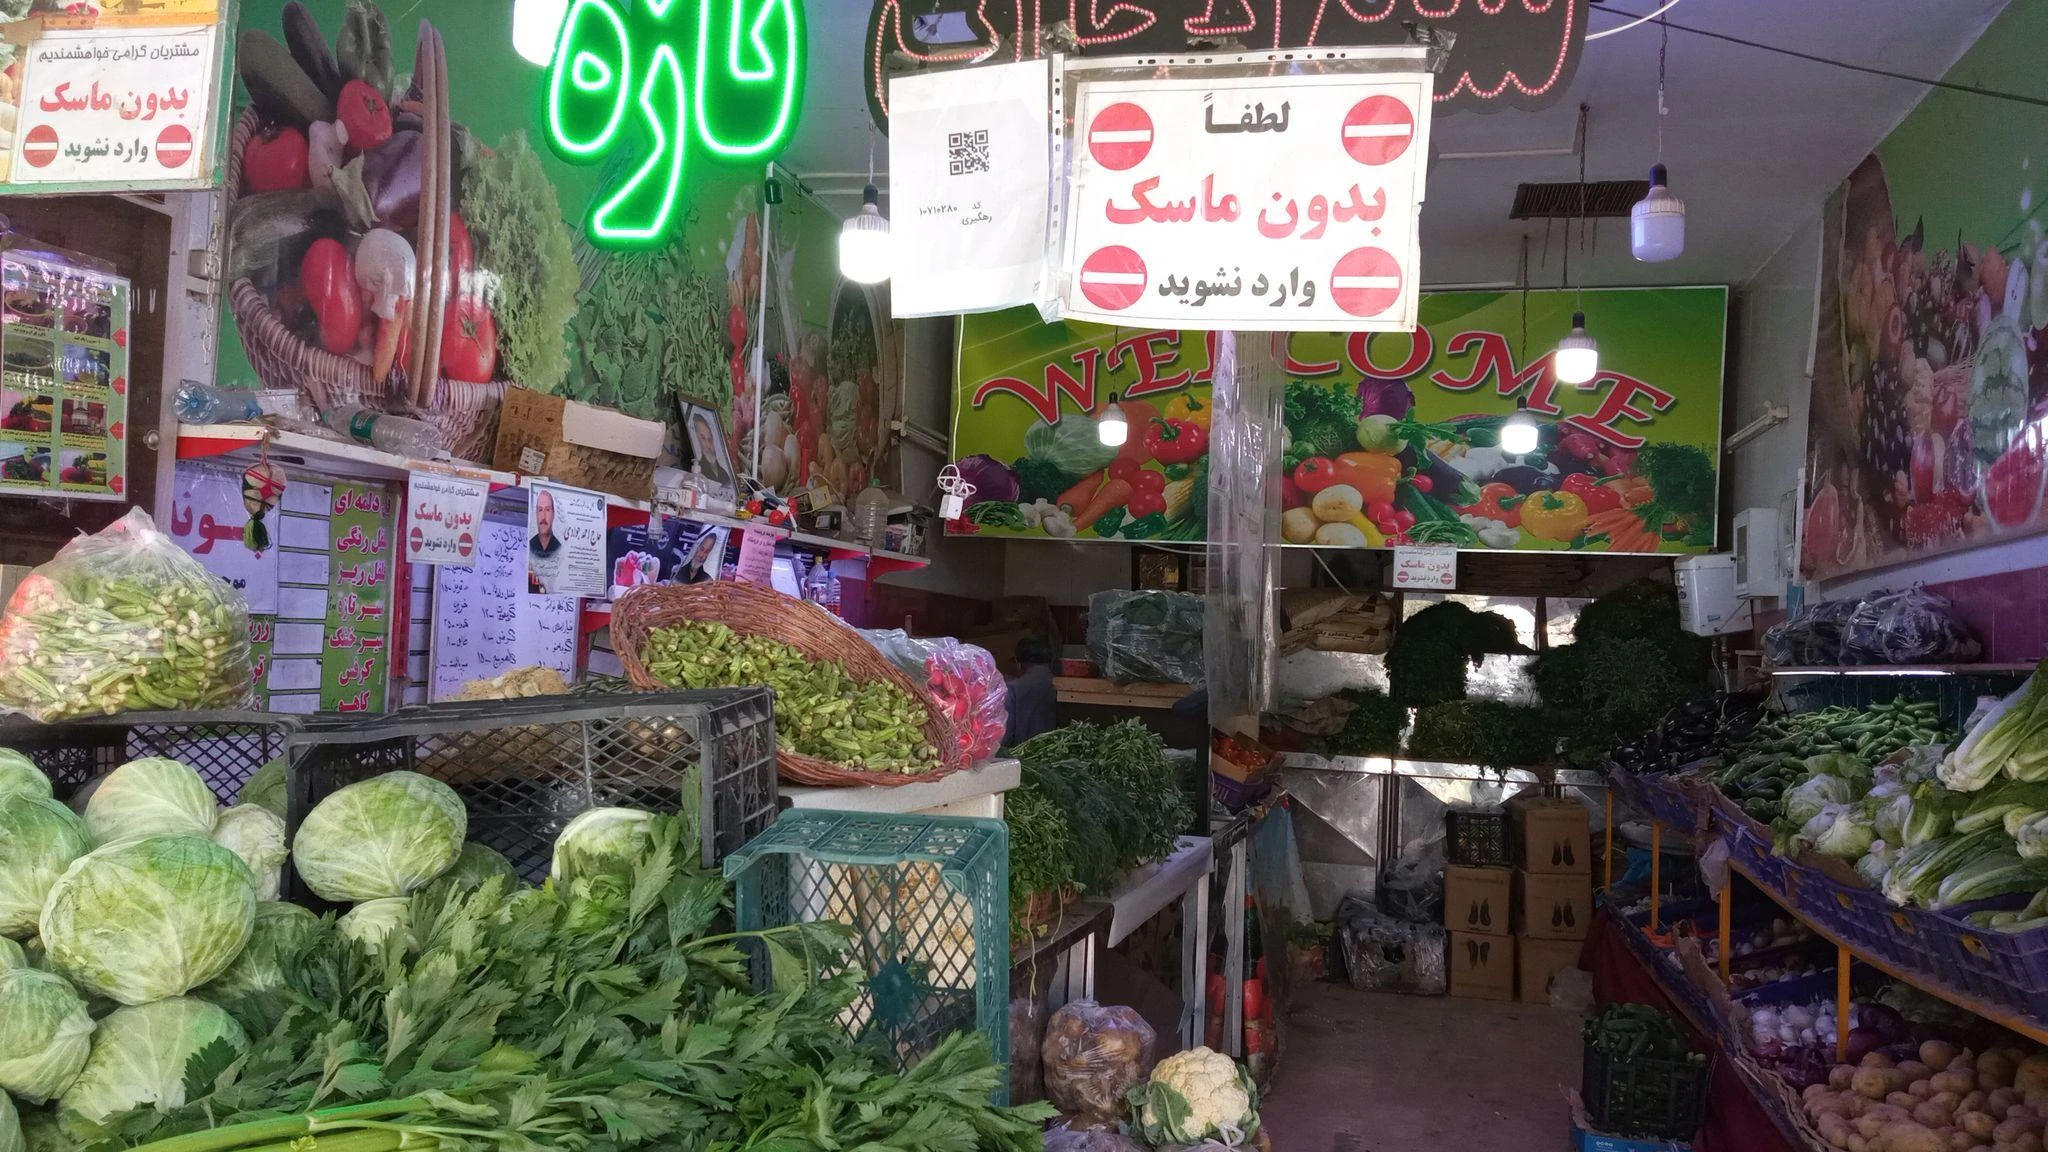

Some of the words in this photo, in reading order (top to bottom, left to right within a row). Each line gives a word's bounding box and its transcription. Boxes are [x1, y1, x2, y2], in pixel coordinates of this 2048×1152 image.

[39, 45, 109, 62] خواهشمندیم
[150, 43, 200, 61] مشتریان
[39, 81, 113, 112] ماسک
[119, 87, 189, 121] بدون
[64, 138, 110, 163] نشوید
[113, 138, 149, 163] وارد
[1105, 173, 1242, 225] ماسک
[1258, 183, 1387, 240] بدون
[961, 212, 992, 226] رهگیری
[1158, 266, 1242, 307] نشوید
[1251, 266, 1316, 307] وارد
[971, 323, 1676, 449] WECOME
[414, 503, 443, 522] ماسک
[445, 512, 472, 530] بدون
[424, 537, 442, 551] نشوید
[443, 539, 457, 553] وارد
